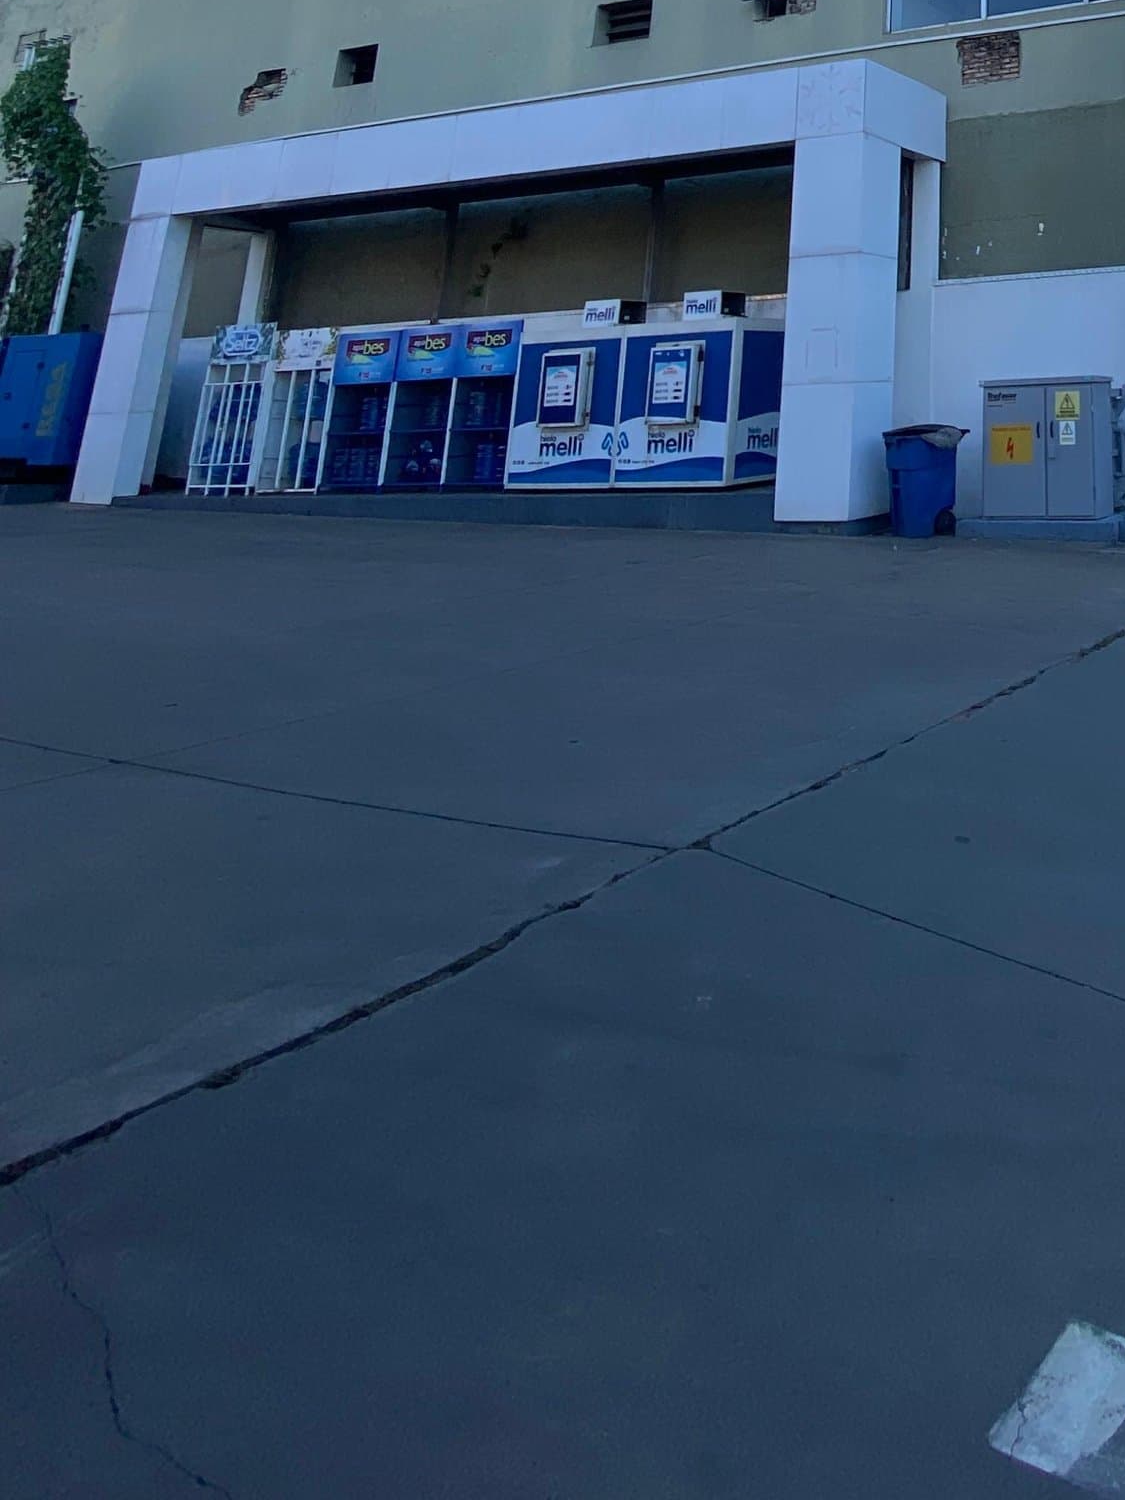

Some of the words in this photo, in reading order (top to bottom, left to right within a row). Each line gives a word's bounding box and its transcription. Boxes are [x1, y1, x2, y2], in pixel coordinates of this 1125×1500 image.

[363, 341, 385, 355] bes
[425, 335, 446, 350] bes
[485, 332, 506, 346] bes
[540, 434, 584, 456] melli
[647, 429, 695, 454] melli
[747, 428, 779, 449] mell
